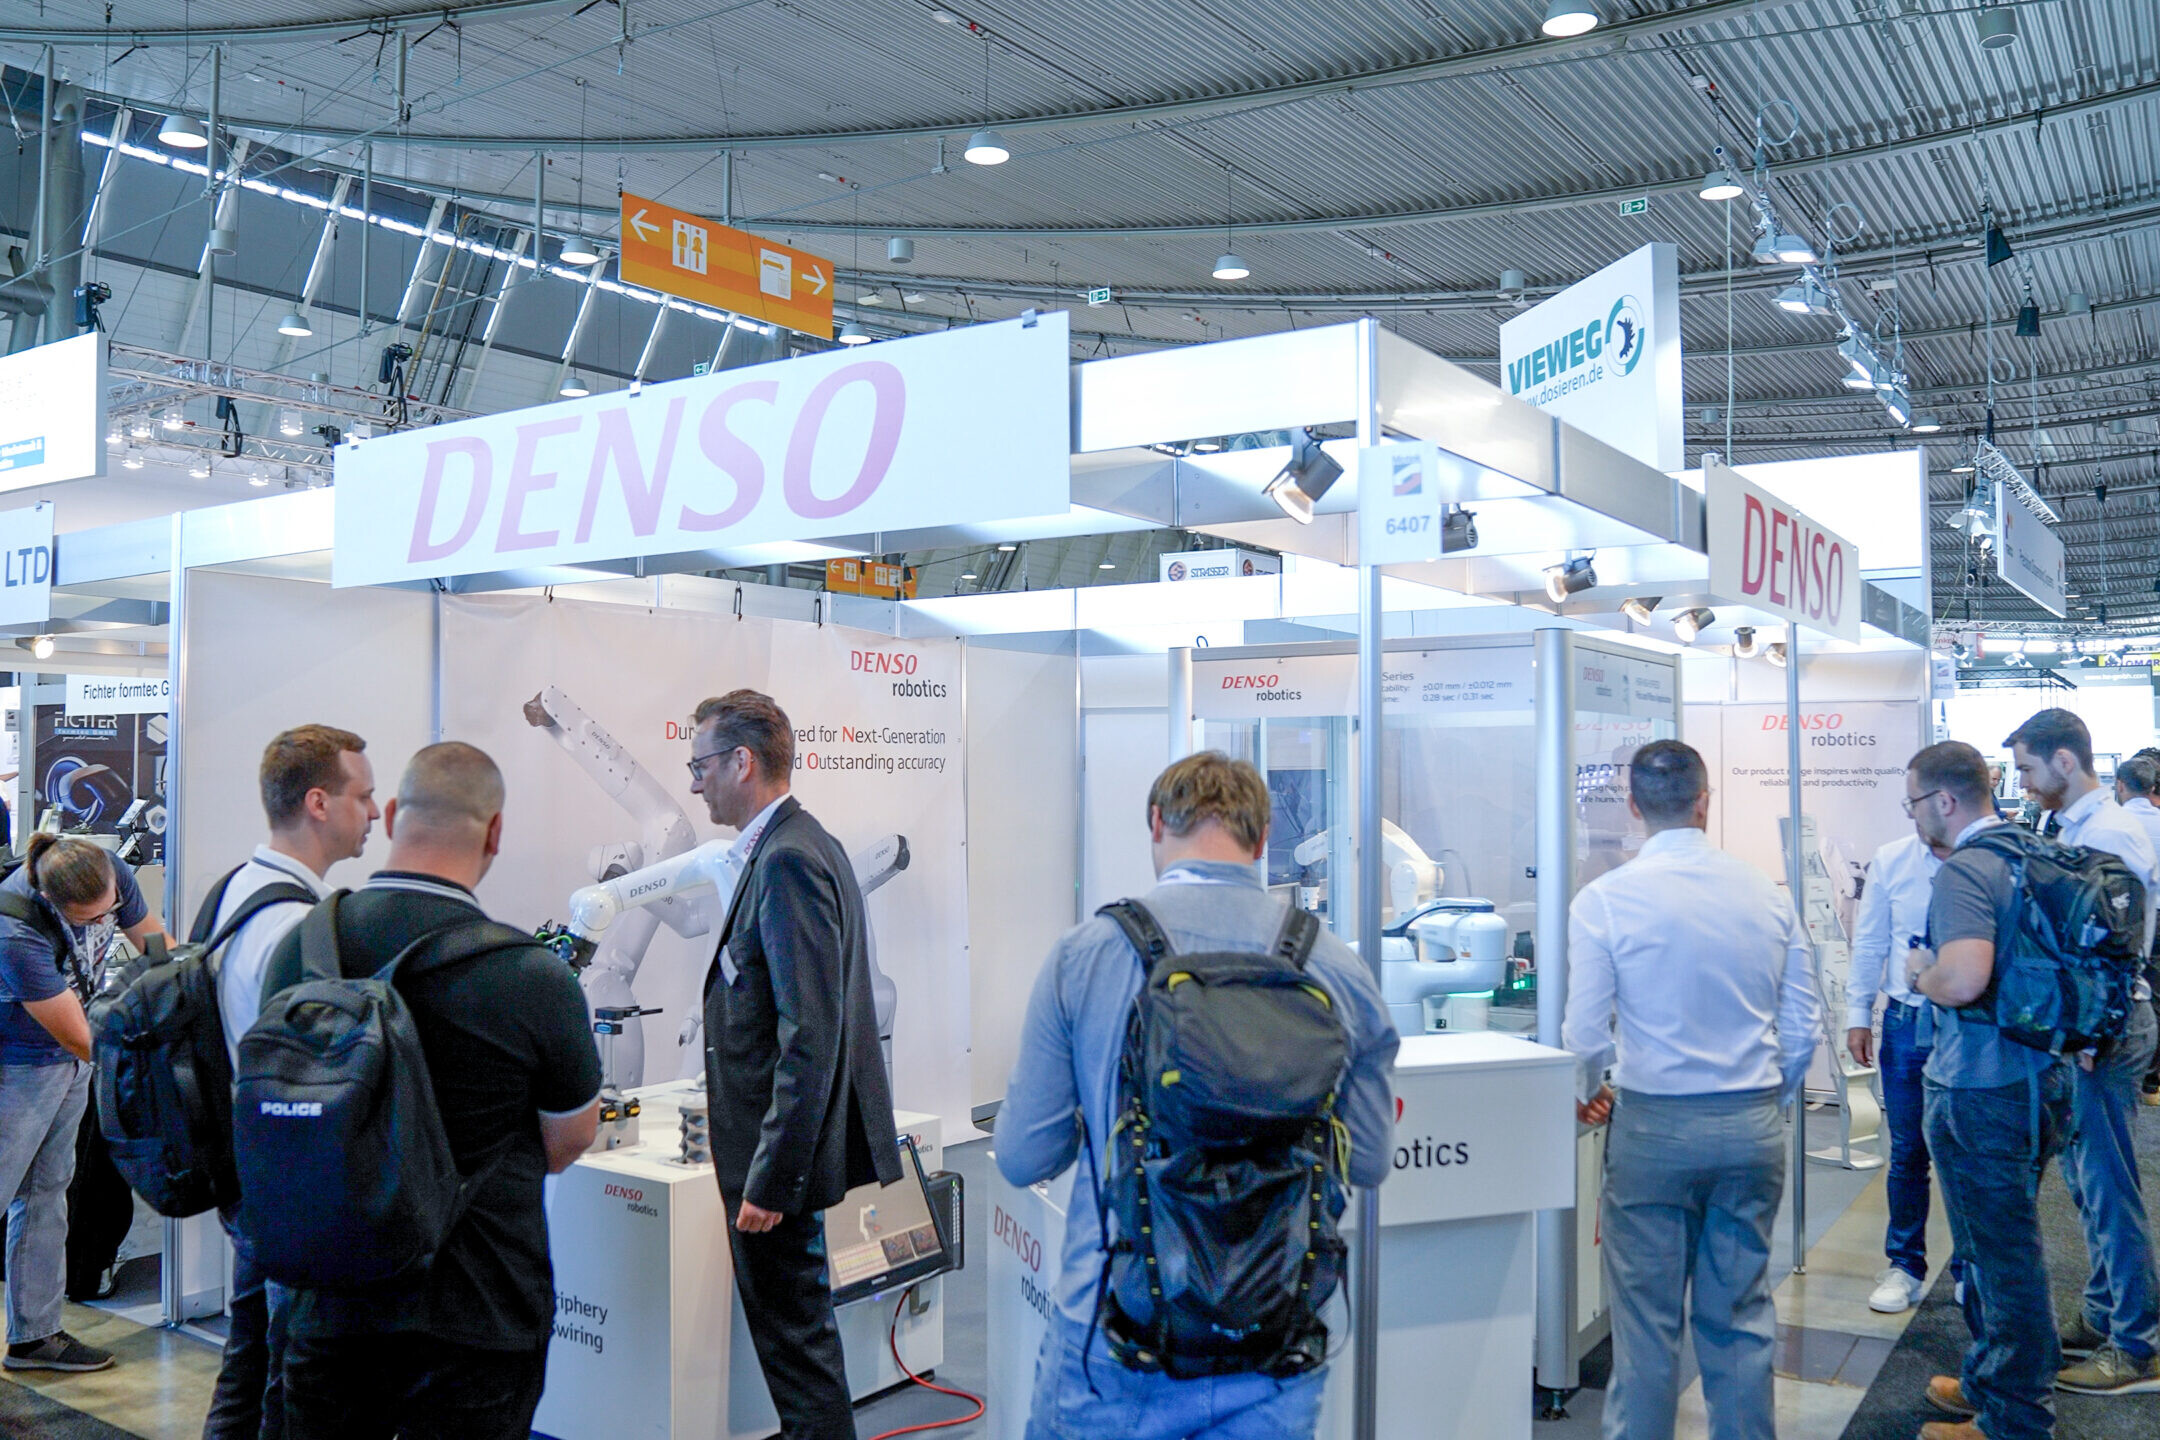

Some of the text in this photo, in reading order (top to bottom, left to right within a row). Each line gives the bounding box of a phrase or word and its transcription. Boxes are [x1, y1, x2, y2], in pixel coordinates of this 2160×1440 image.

[1508, 319, 1602, 395] VIEWEG
[407, 360, 907, 563] DENSO
[1386, 515, 1430, 535] 6407
[5, 545, 50, 588] LTD
[1742, 493, 1843, 626] DENSO
[1190, 566, 1230, 578] STRASSER
[851, 650, 918, 675] DENSO
[83, 684, 117, 700] Fichter
[119, 682, 159, 698] formtec
[892, 679, 947, 698] robotics
[1221, 674, 1279, 689] DENSO
[1256, 689, 1302, 701] robotics
[818, 725, 837, 742] for
[842, 726, 946, 744] Next-Generation
[1811, 731, 1876, 746] robotics
[807, 752, 894, 774] Outstanding
[898, 756, 946, 774] accuracy
[1732, 767, 1748, 775] Our
[1750, 767, 1785, 777] product
[1813, 767, 1850, 777] inspires
[1852, 767, 1872, 775] with
[1803, 779, 1819, 787] and
[1821, 778, 1878, 789] productivity
[630, 878, 667, 898] DENSO
[260, 1102, 322, 1116] POLICE
[1393, 1136, 1470, 1170] otics
[604, 1183, 643, 1202] DENSO
[627, 1202, 658, 1217] robotics
[994, 1204, 1042, 1273] DENSO
[556, 1291, 608, 1325] iphery
[1021, 1274, 1051, 1322] roboti
[556, 1322, 603, 1354] wiring
